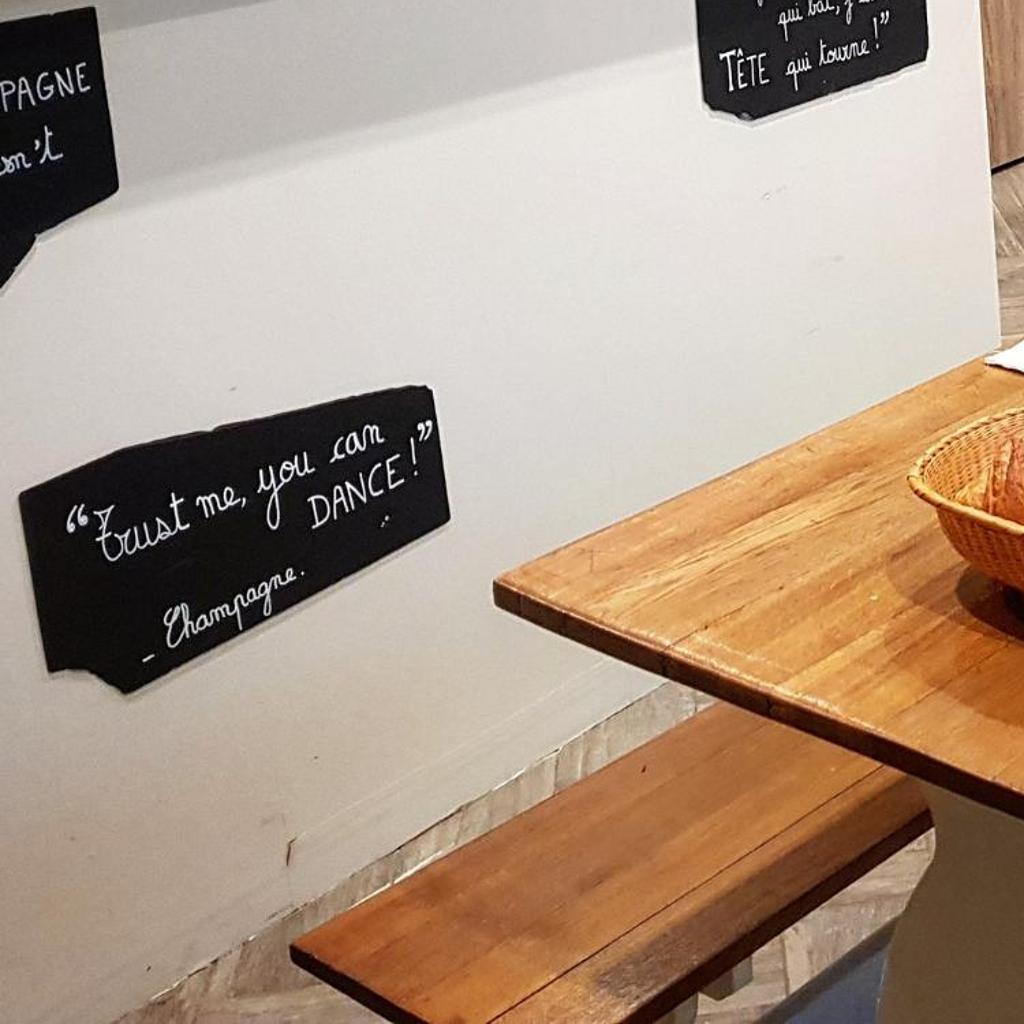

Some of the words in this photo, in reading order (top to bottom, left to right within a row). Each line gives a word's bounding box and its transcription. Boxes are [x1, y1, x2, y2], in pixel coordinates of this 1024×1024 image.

[777, 2, 804, 43] qui
[719, 47, 770, 92] TÊTE
[785, 51, 812, 91] qui
[818, 39, 871, 67] tourne
[196, 484, 249, 518] me,
[257, 450, 316, 531] you
[329, 423, 385, 464] can
[307, 455, 405, 529] DANCE
